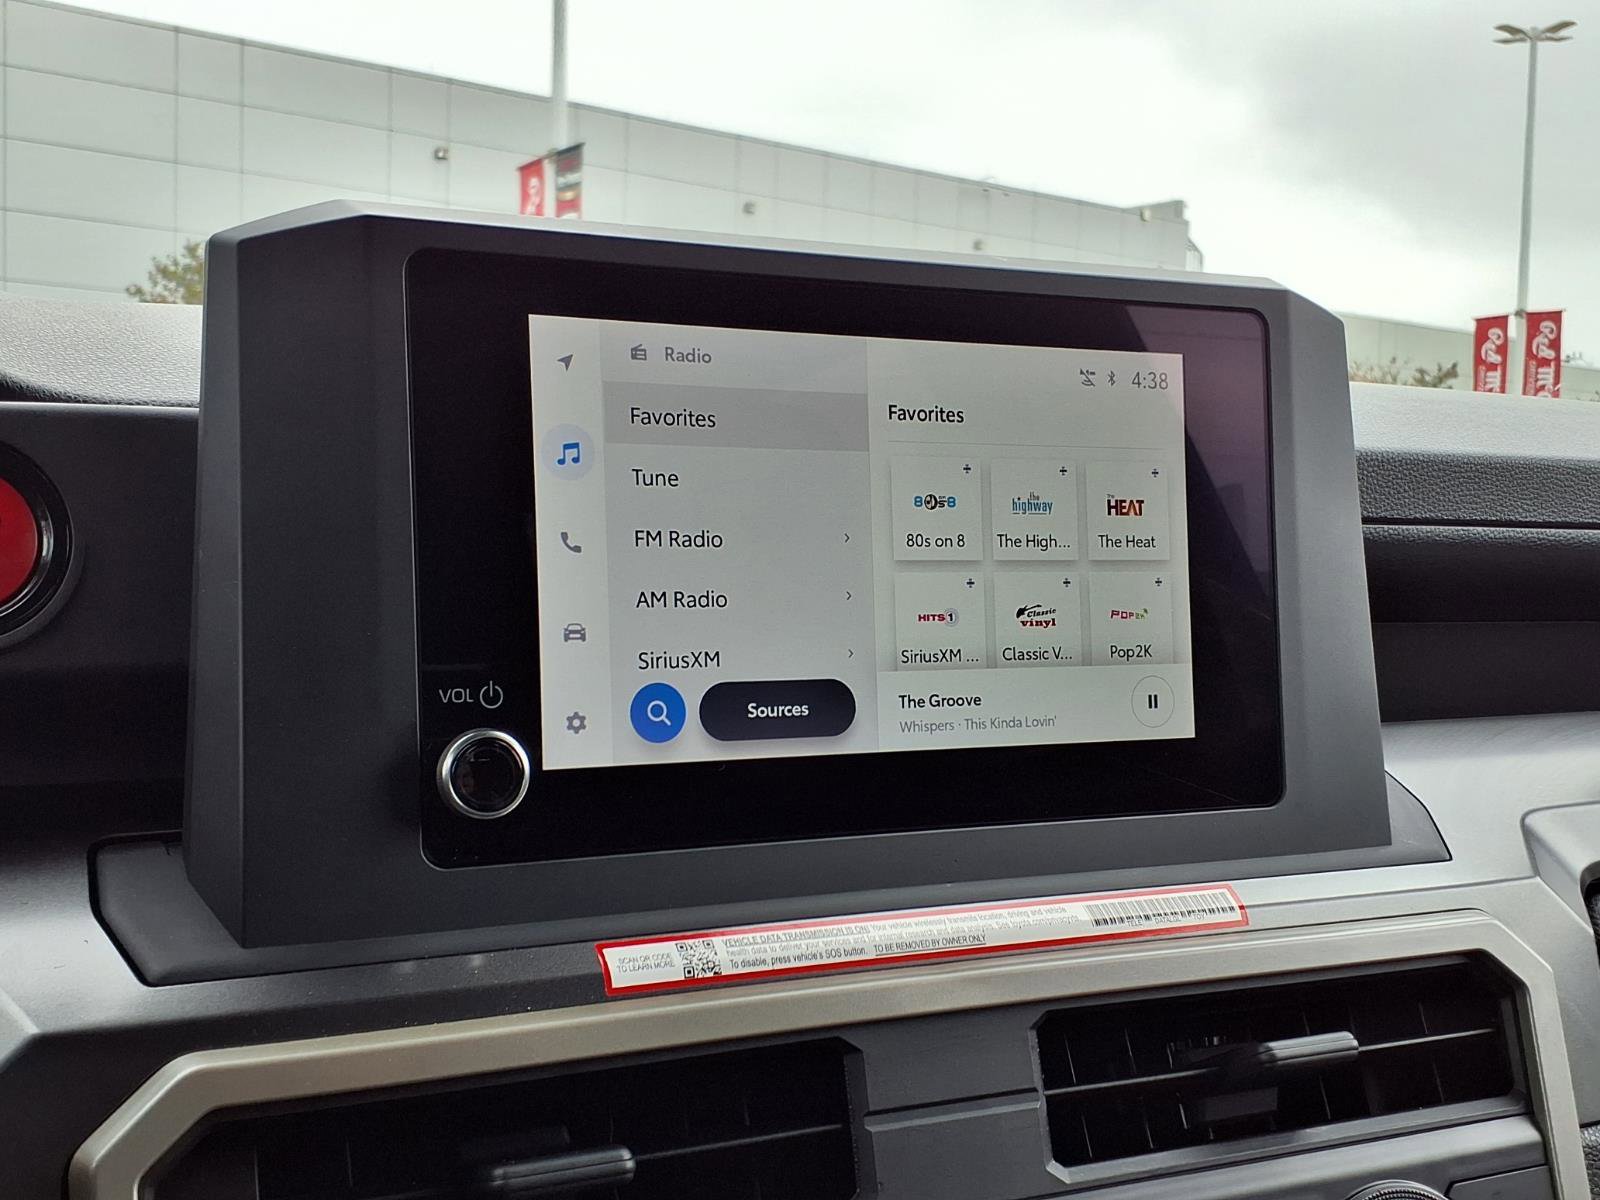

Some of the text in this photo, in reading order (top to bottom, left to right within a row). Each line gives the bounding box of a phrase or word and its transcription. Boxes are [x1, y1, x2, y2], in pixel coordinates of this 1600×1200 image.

[664, 346, 712, 364] Radio
[1131, 371, 1169, 390] 4:38
[630, 407, 716, 428] Favorites
[888, 404, 965, 424] Favorites
[632, 468, 679, 487] Tune
[1012, 496, 1054, 515] highway
[1107, 499, 1145, 516] HEAT
[634, 529, 723, 548] FM Radio
[906, 533, 966, 548] 80s on 8
[997, 533, 1071, 551] The High...
[1098, 534, 1156, 549] The Heat
[636, 590, 728, 609] AM Radio
[918, 613, 945, 622] HITS
[1020, 618, 1057, 629] vinyl
[901, 648, 962, 665] SiriusXM
[1002, 646, 1049, 662] Classic
[1110, 644, 1152, 659] Pop2K
[638, 651, 721, 671] SiriusXM
[438, 688, 474, 704] VOL
[899, 693, 982, 709] The Groove
[747, 701, 810, 719] Sources
[899, 715, 1057, 734] Whispers This Kinda Lovin'
[721, 937, 758, 948] VEHICLE
[760, 935, 782, 944] DATA
[730, 959, 739, 969] To
[741, 956, 769, 968] disable,
[771, 954, 791, 966] press
[792, 951, 823, 962] vehicle's
[825, 948, 842, 958] SOS
[873, 944, 884, 953] TO
[885, 943, 895, 952] BE
[895, 939, 931, 951] REMOVED
[932, 938, 941, 947] BY
[942, 935, 967, 946] OWNER
[968, 933, 986, 943] ONLY
